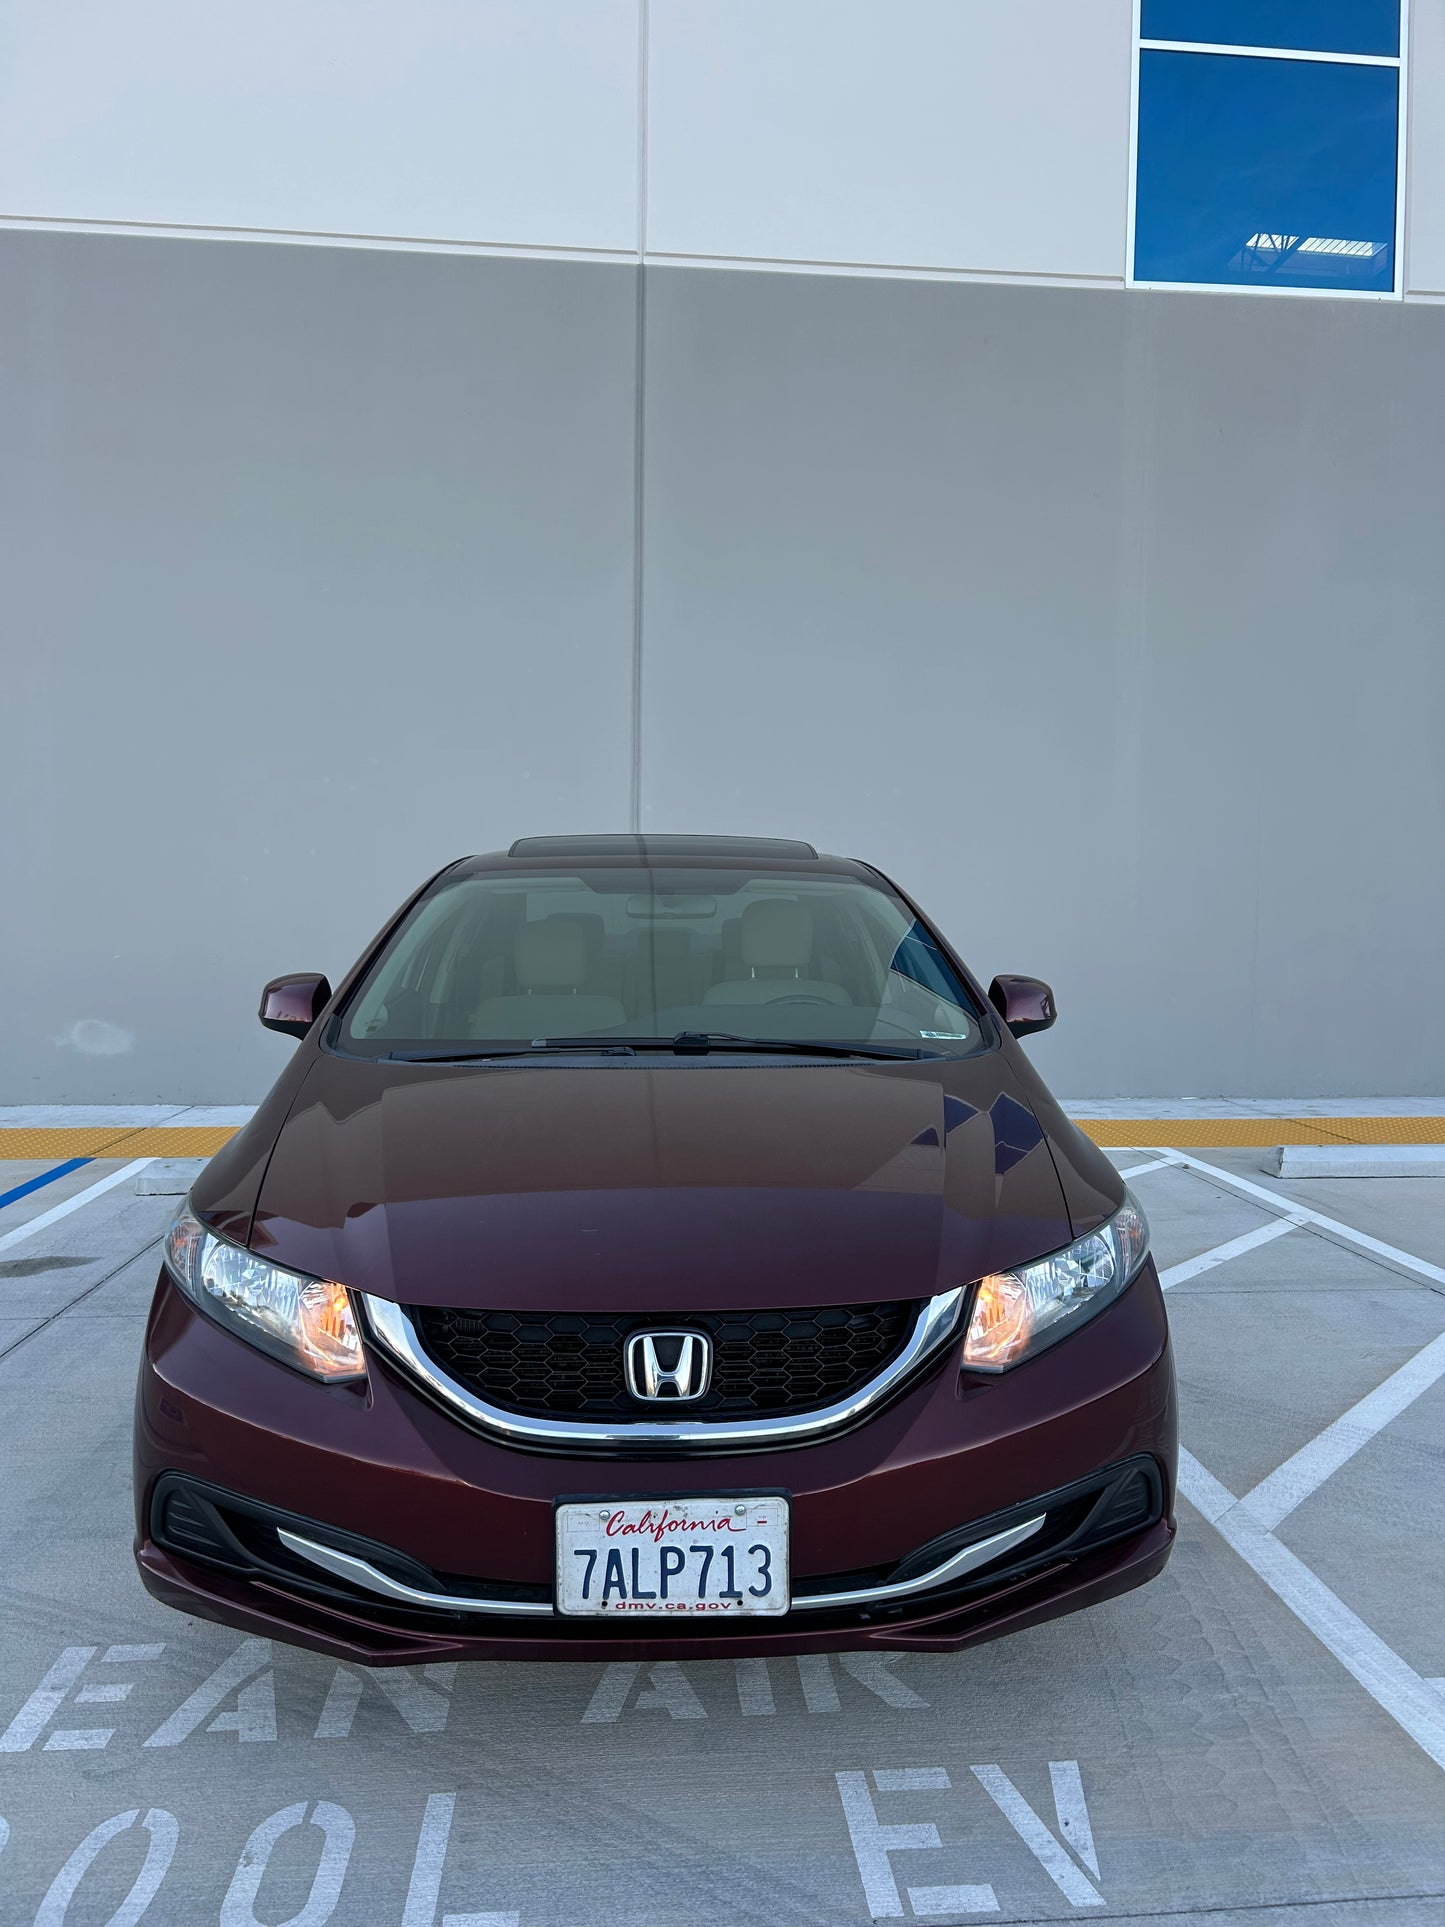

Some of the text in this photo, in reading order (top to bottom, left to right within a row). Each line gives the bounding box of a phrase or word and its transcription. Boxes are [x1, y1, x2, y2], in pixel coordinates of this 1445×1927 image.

[606, 1509, 747, 1543] California
[573, 1543, 773, 1600] 7ALP713
[615, 1601, 732, 1611] dmv.ca.gov
[0, 1759, 1107, 1927] OOL EV
